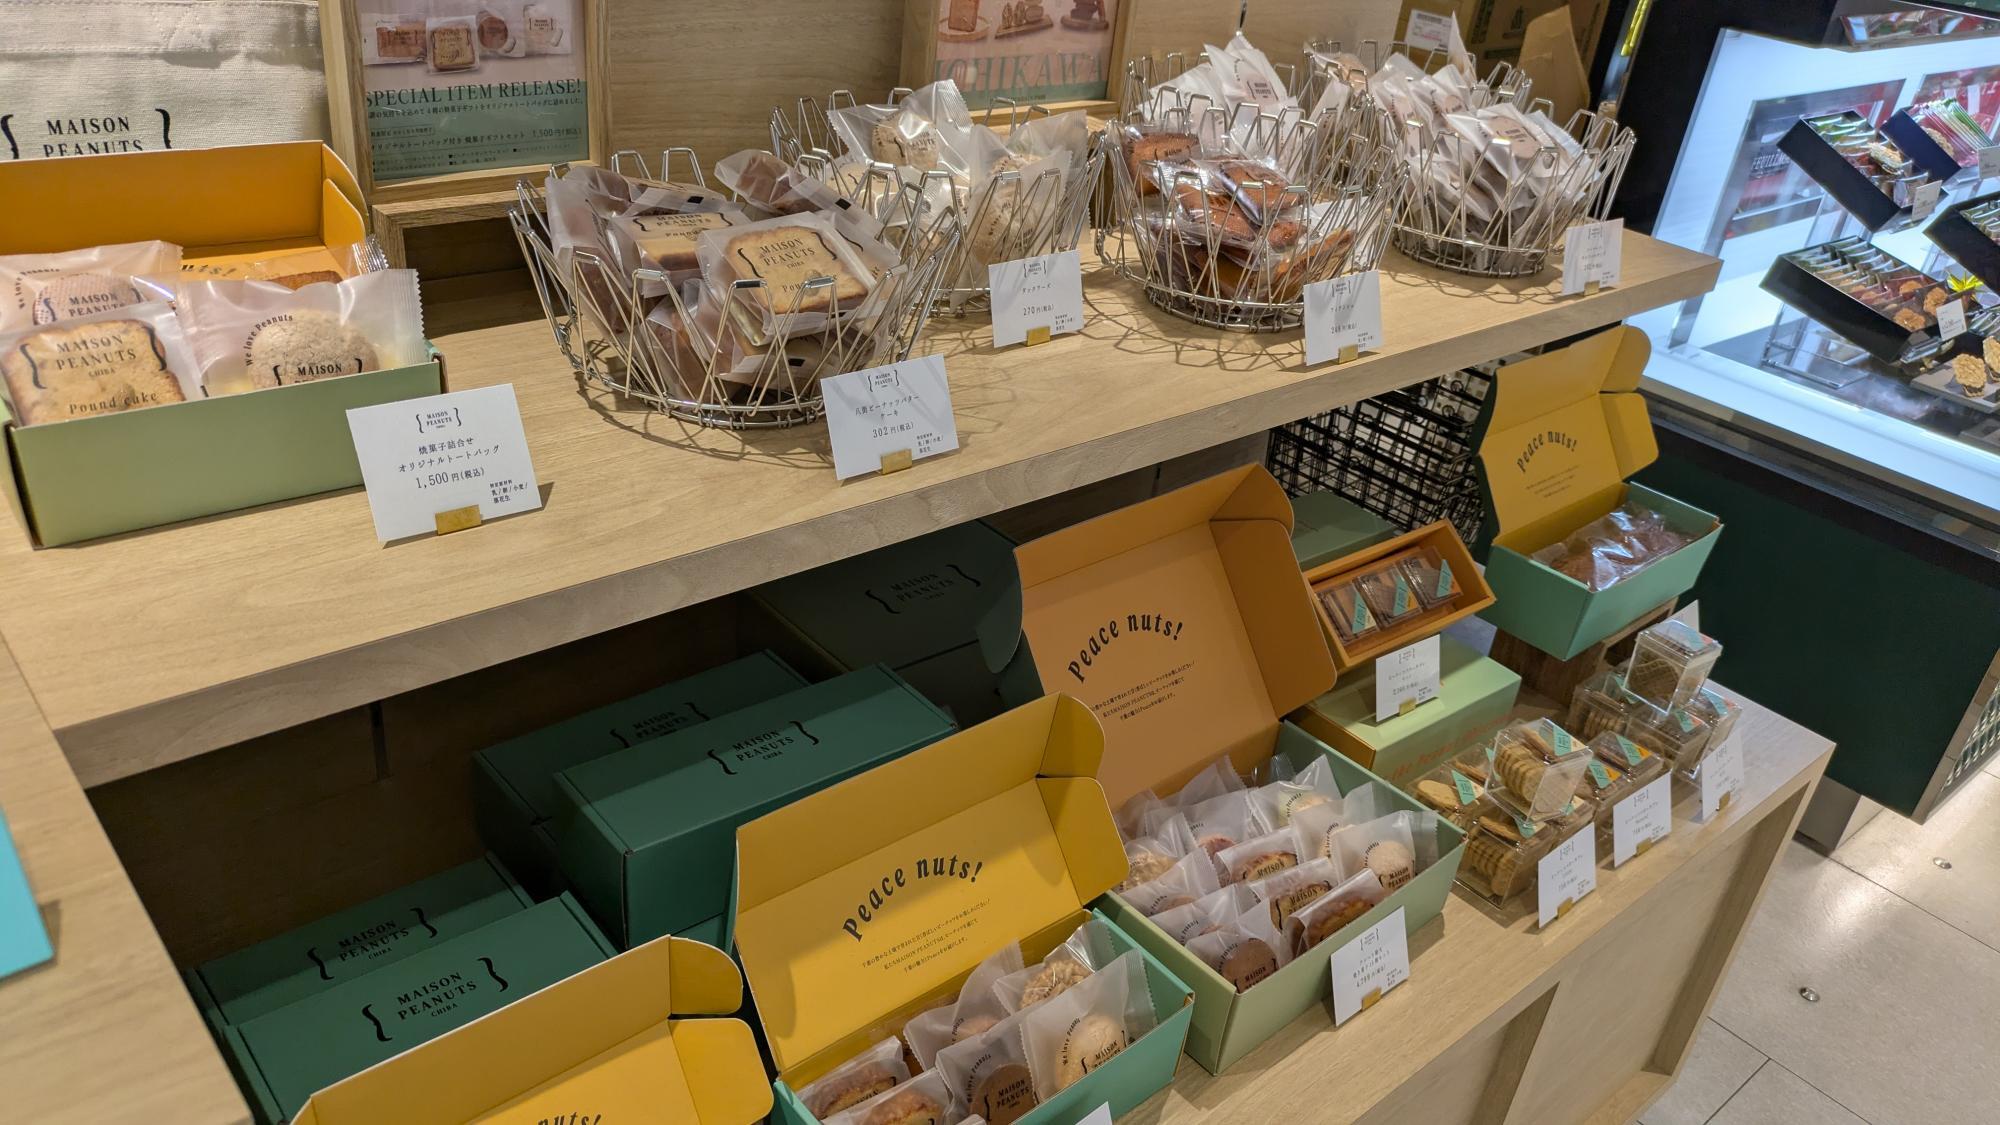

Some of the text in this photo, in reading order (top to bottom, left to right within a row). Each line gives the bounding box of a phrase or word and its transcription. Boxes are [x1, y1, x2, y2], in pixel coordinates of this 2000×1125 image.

[366, 78, 582, 107] SPECIAL ITEM RELEASE!
[47, 116, 131, 136] MAISON
[43, 139, 144, 158] PEANUTS
[759, 237, 805, 255] MAISON
[763, 247, 816, 266] PEANUTS
[68, 291, 120, 306] MAISON
[55, 334, 125, 354] MAISON
[56, 348, 138, 371] PEANUTS
[297, 363, 343, 376] MAISON
[69, 391, 158, 415] Pound cake
[418, 436, 475, 456] 焼菓子詰合せ
[1516, 431, 1578, 473] Peace nuts!
[398, 444, 500, 473] オリジナルトートバッグ
[890, 573, 939, 592] MAISON
[896, 579, 954, 602] PEANUTS
[1067, 613, 1183, 684] Peace nuts!
[632, 710, 677, 730] MAISON
[635, 715, 689, 739] PEANUTS
[732, 729, 782, 751] MAISON
[736, 735, 795, 762] PEANUTS
[1256, 858, 1286, 878] MAISON
[1389, 866, 1409, 879] MAISON
[842, 854, 983, 943] Peace nuts!
[1289, 887, 1318, 905] MAISON
[338, 919, 399, 949] MAISON
[338, 927, 410, 962] PEANUTS
[368, 947, 393, 961] CHIBA
[1244, 966, 1266, 981] MAISON
[396, 972, 463, 1006] MAISON
[397, 980, 478, 1021] PEANUTS
[431, 1003, 459, 1017] CHIBA
[1094, 1040, 1119, 1061] MAISON
[996, 1087, 1030, 1109] PEANUTS
[998, 1079, 1026, 1099] MAISON
